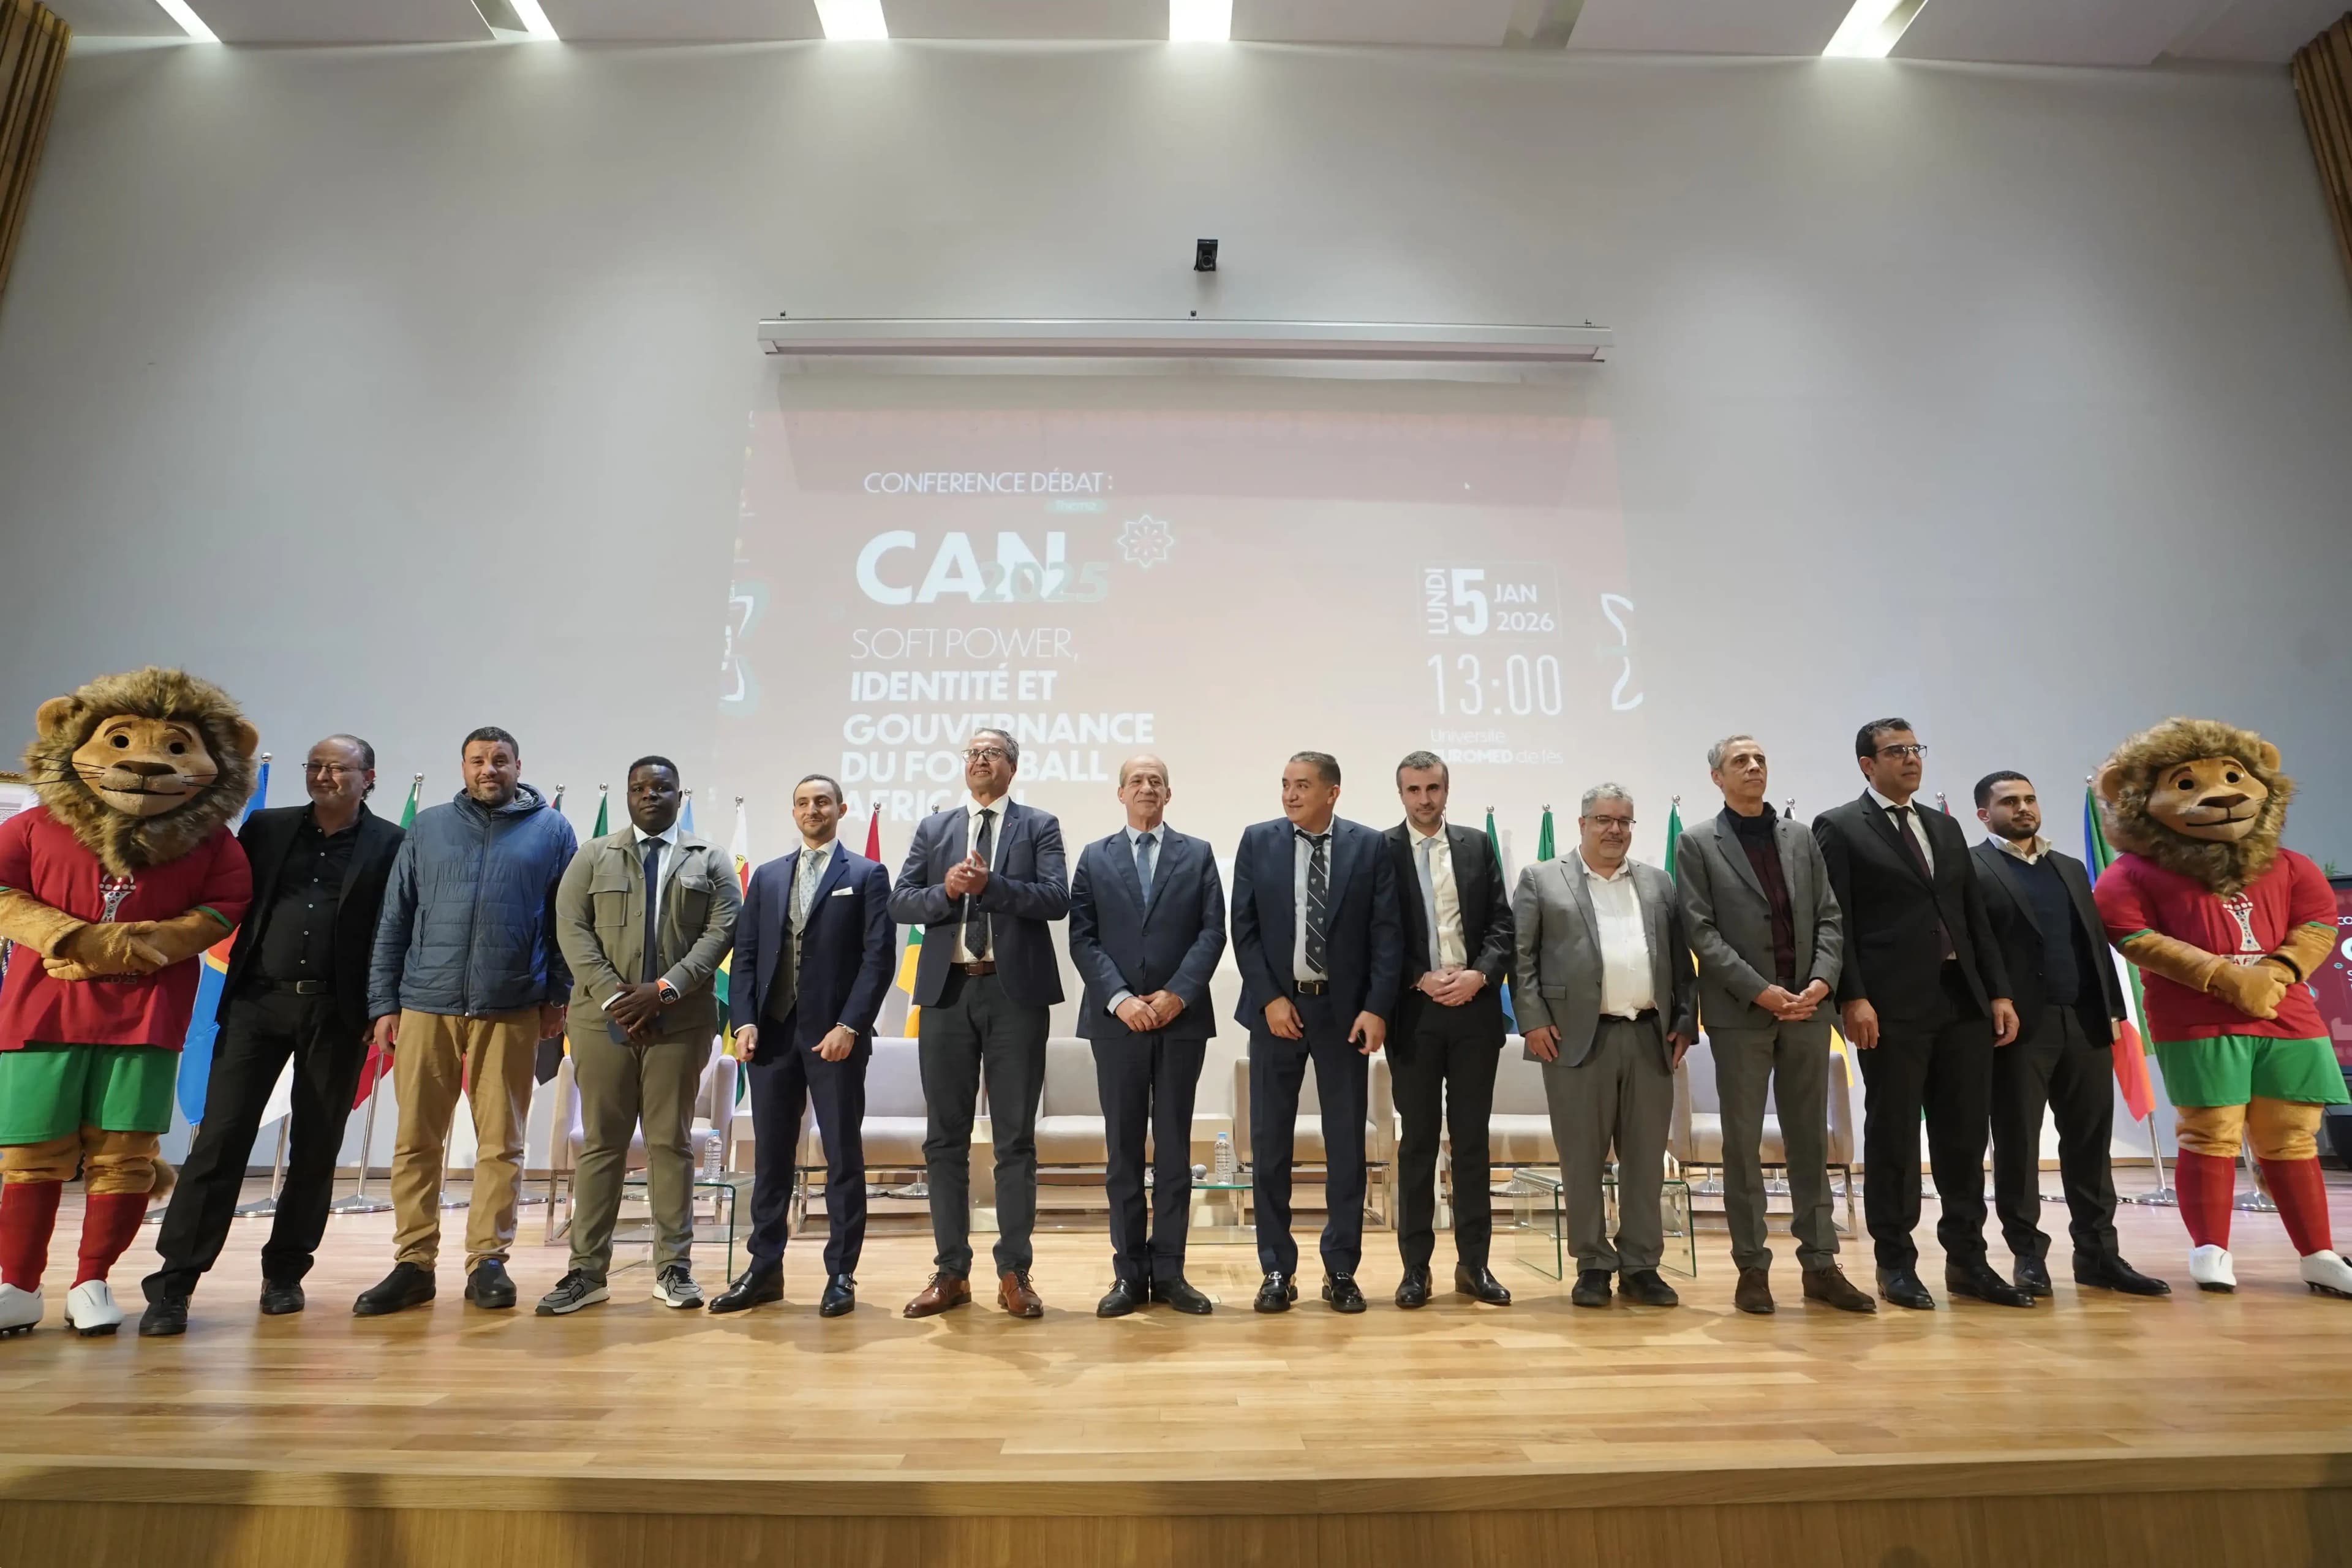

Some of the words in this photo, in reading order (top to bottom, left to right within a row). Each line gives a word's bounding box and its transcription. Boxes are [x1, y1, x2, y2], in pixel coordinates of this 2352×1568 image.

[864, 472, 1026, 493] CONFERENCE
[856, 530, 1066, 605] CAN
[976, 560, 1110, 603] 2025
[1424, 568, 1449, 635] LUNDI
[1451, 568, 1488, 636] 5
[1494, 584, 1537, 603] JAN
[1496, 612, 1555, 632] 2026
[851, 628, 940, 660] SOFT
[945, 627, 1079, 662] POWER,
[850, 662, 1009, 702] IDENTITÉ
[1017, 670, 1058, 701] ET
[1427, 654, 1562, 716] 13:00
[840, 752, 897, 783] DU
[904, 750, 1109, 783] FOBALL
